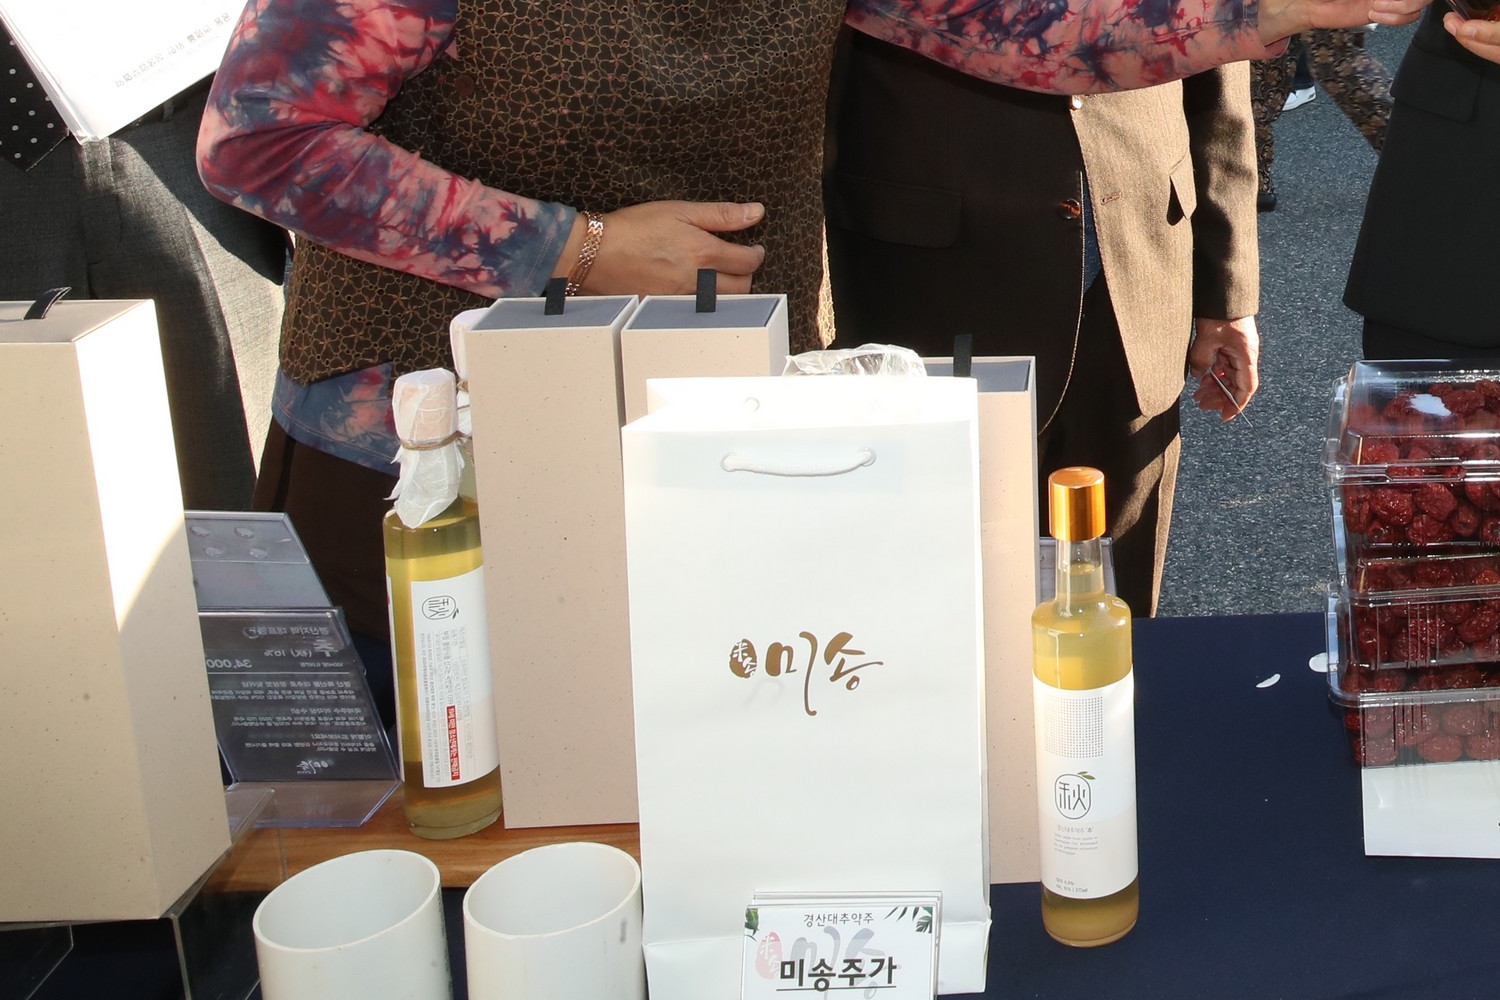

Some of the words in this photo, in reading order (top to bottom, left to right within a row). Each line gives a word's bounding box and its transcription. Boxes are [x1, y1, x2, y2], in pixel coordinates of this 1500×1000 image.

[1058, 781, 1087, 811] 秋
[803, 912, 875, 928] 경산대추약주
[779, 957, 898, 992] 미송주가
